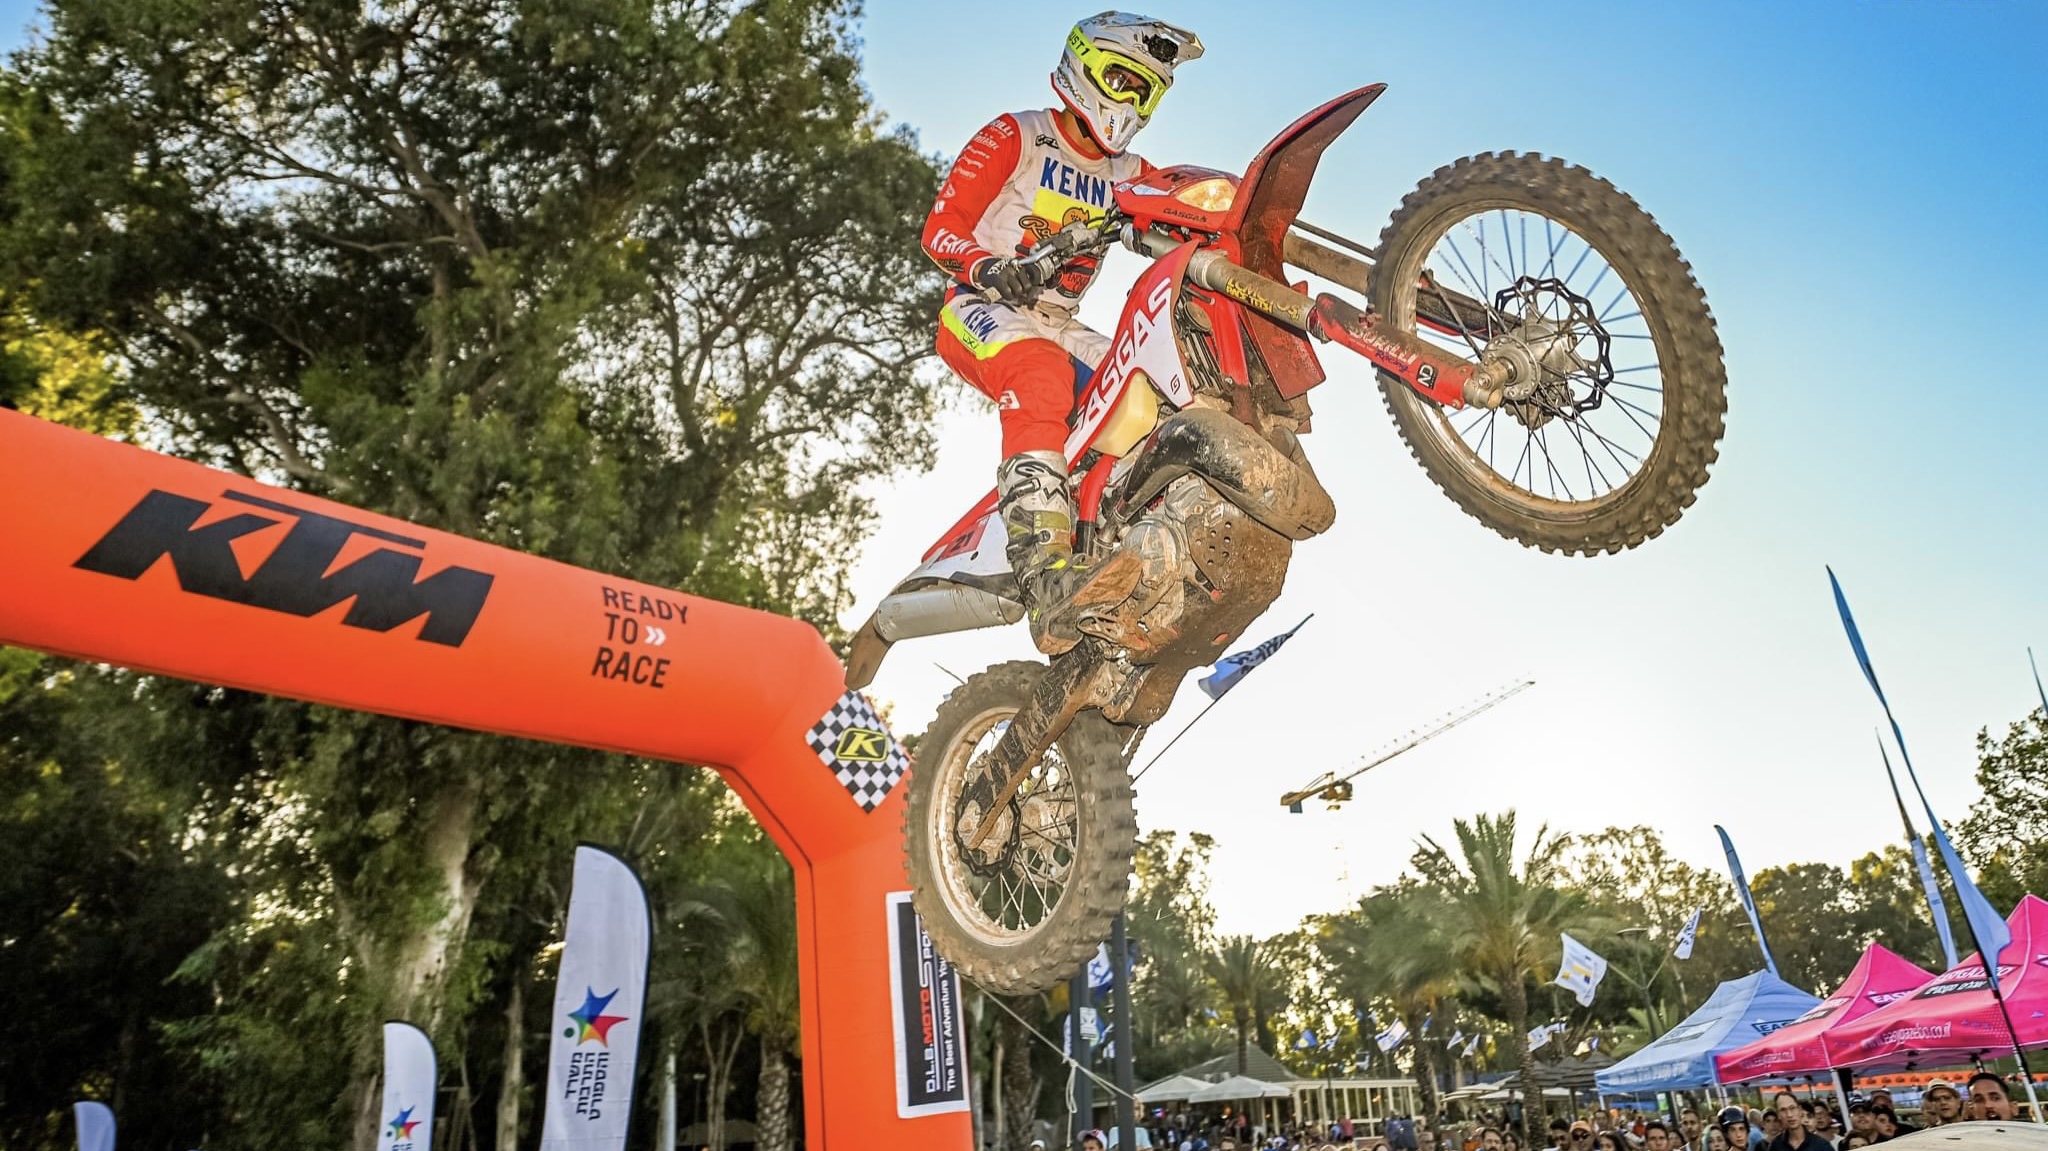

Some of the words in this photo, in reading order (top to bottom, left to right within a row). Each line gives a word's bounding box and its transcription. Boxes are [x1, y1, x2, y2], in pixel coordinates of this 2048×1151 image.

[1068, 32, 1091, 56] UST1
[71, 488, 496, 648] KTM
[601, 585, 690, 625] READY
[603, 613, 639, 645] TO
[591, 647, 672, 689] RACE
[938, 980, 953, 1038] Adventure
[943, 1040, 955, 1067] Best
[564, 1052, 582, 1099] משרד
[576, 1052, 595, 1114] התרבות
[588, 1051, 611, 1121] והספורט
[945, 1067, 957, 1092] The
